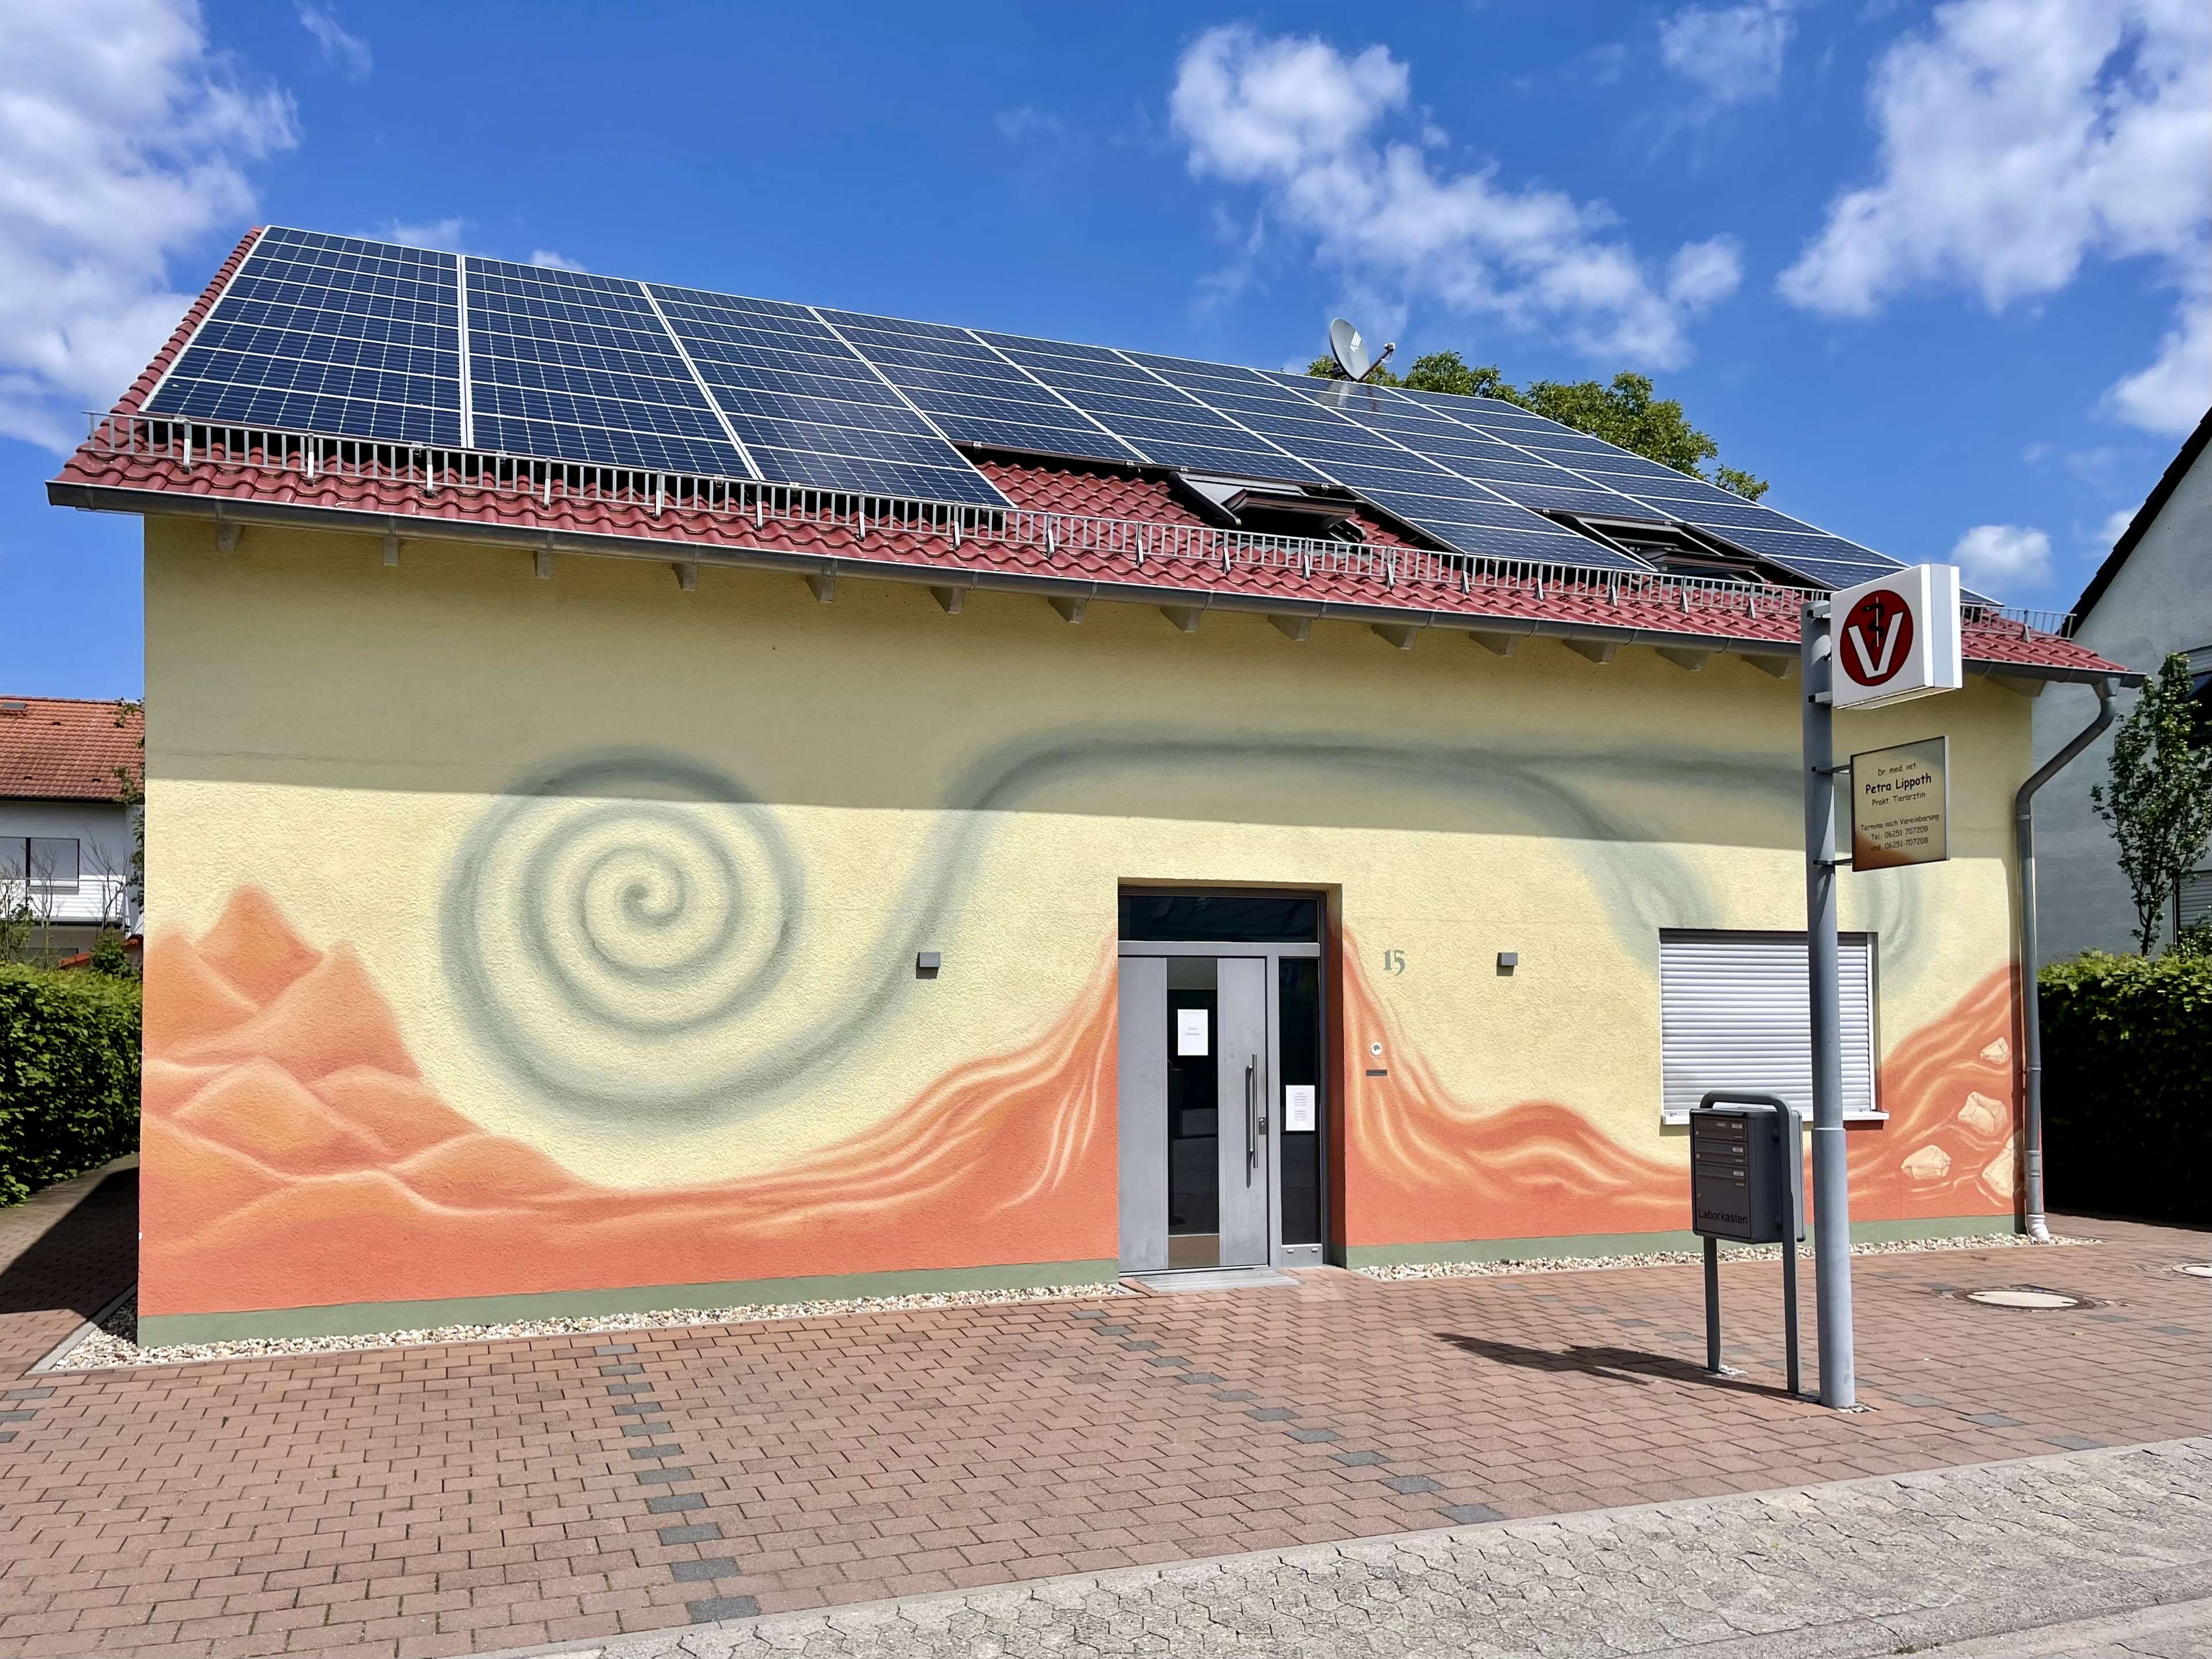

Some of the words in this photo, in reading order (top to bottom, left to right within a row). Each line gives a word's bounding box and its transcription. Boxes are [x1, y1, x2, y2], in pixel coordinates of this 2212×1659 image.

[1866, 783, 1891, 794] Petra
[1896, 773, 1931, 791] Lippoth
[1893, 792, 1925, 802] Tierärztin
[1900, 815, 1939, 825] Vereinbarung
[1382, 949, 1405, 976] 15
[1698, 1209, 1748, 1224] Laborkasten
